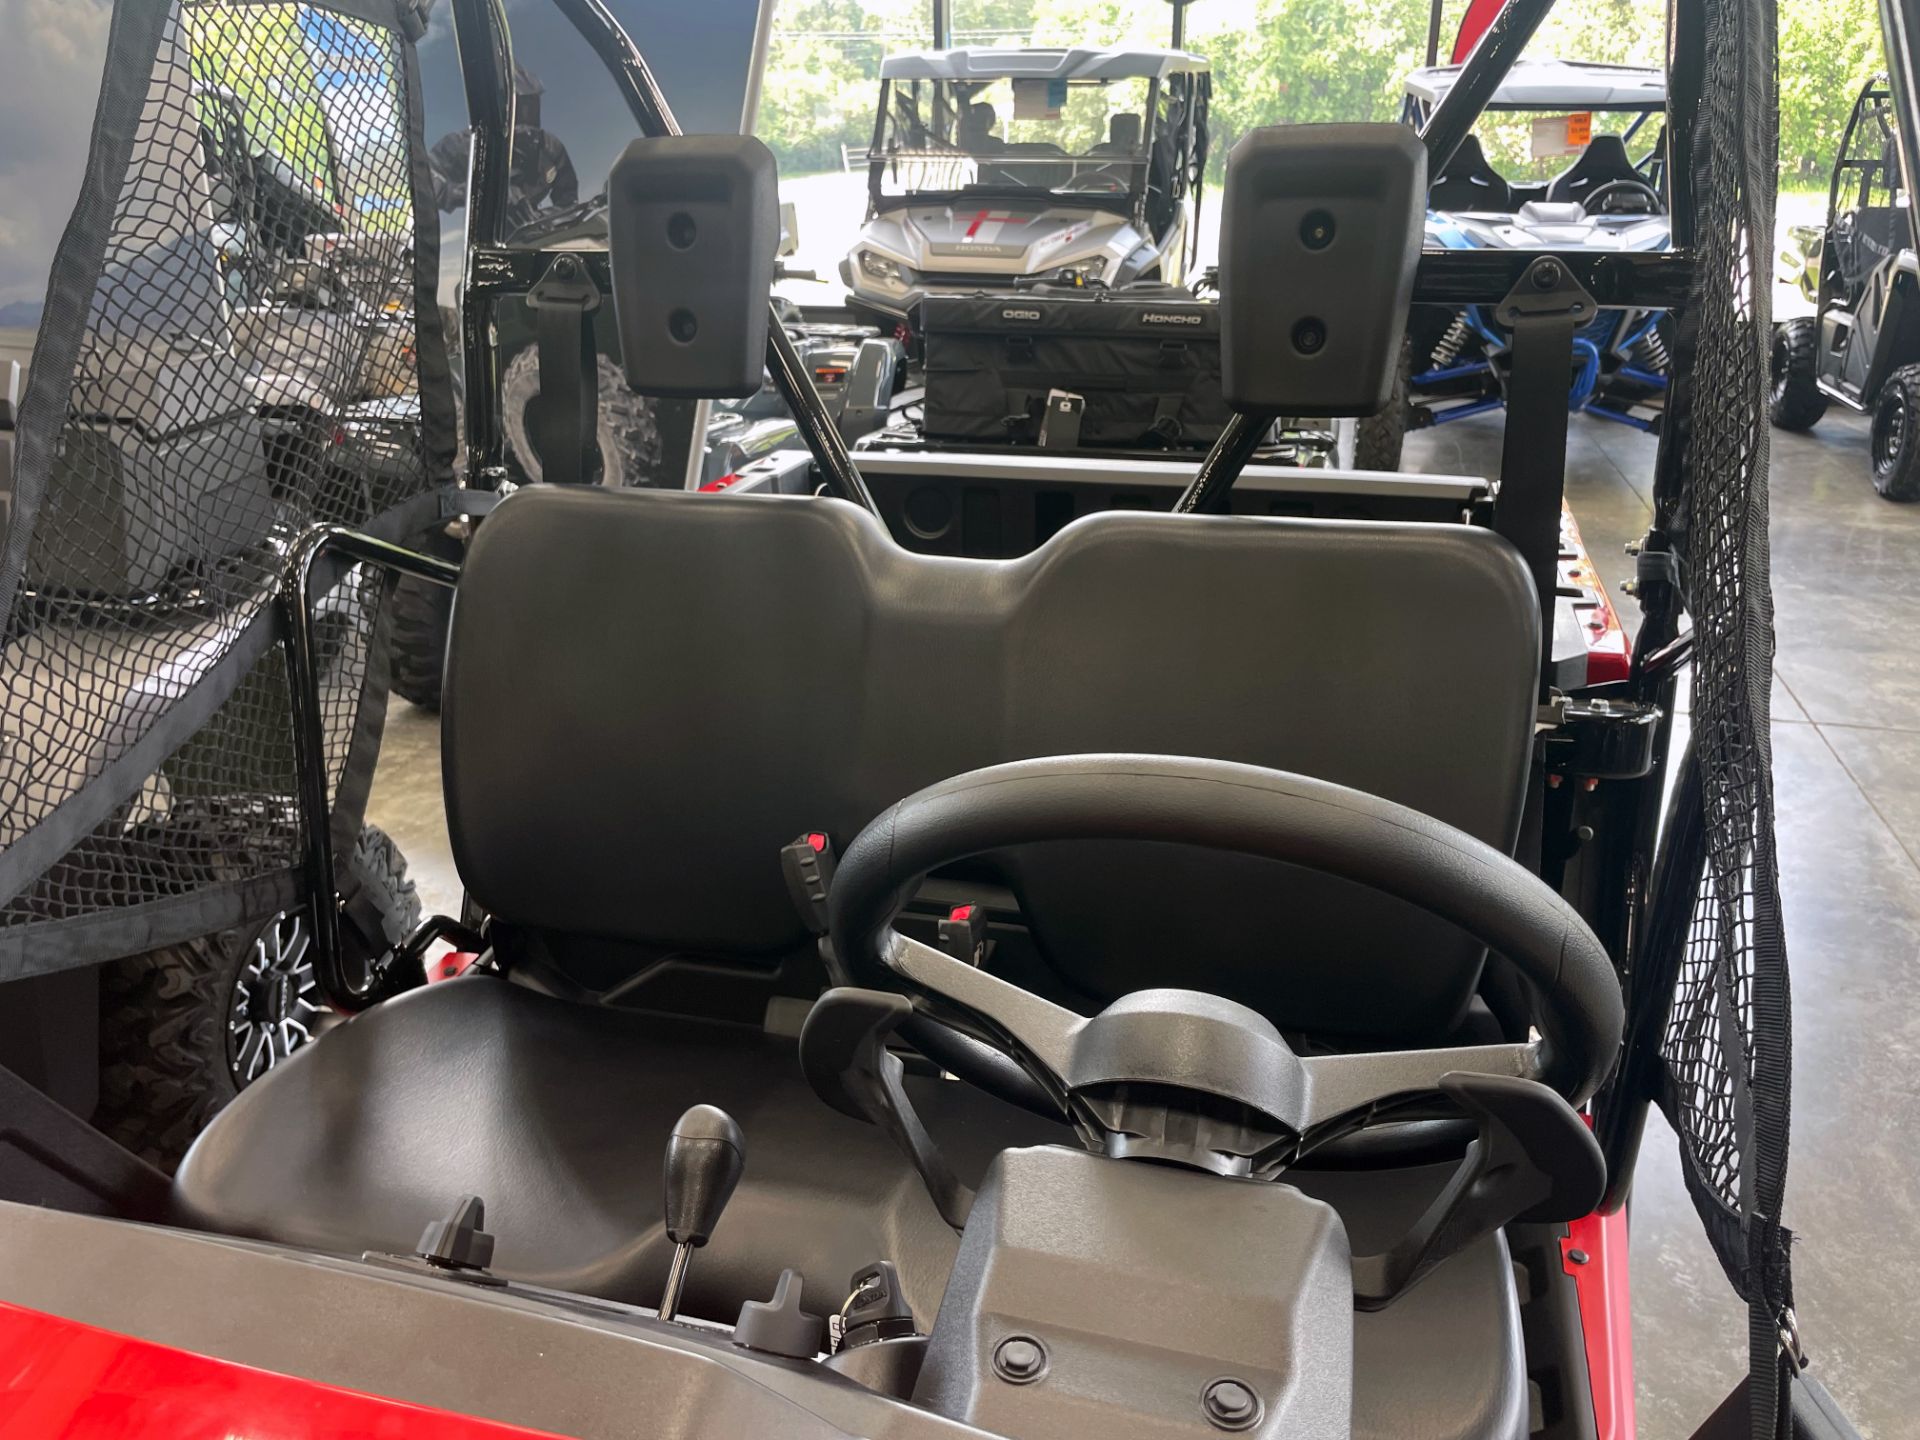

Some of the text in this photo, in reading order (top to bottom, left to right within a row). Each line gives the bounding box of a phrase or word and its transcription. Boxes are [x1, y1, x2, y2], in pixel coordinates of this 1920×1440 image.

[955, 244, 1002, 253] HONDA
[1002, 309, 1041, 320] OGIO
[1142, 313, 1202, 325] HONCHO
